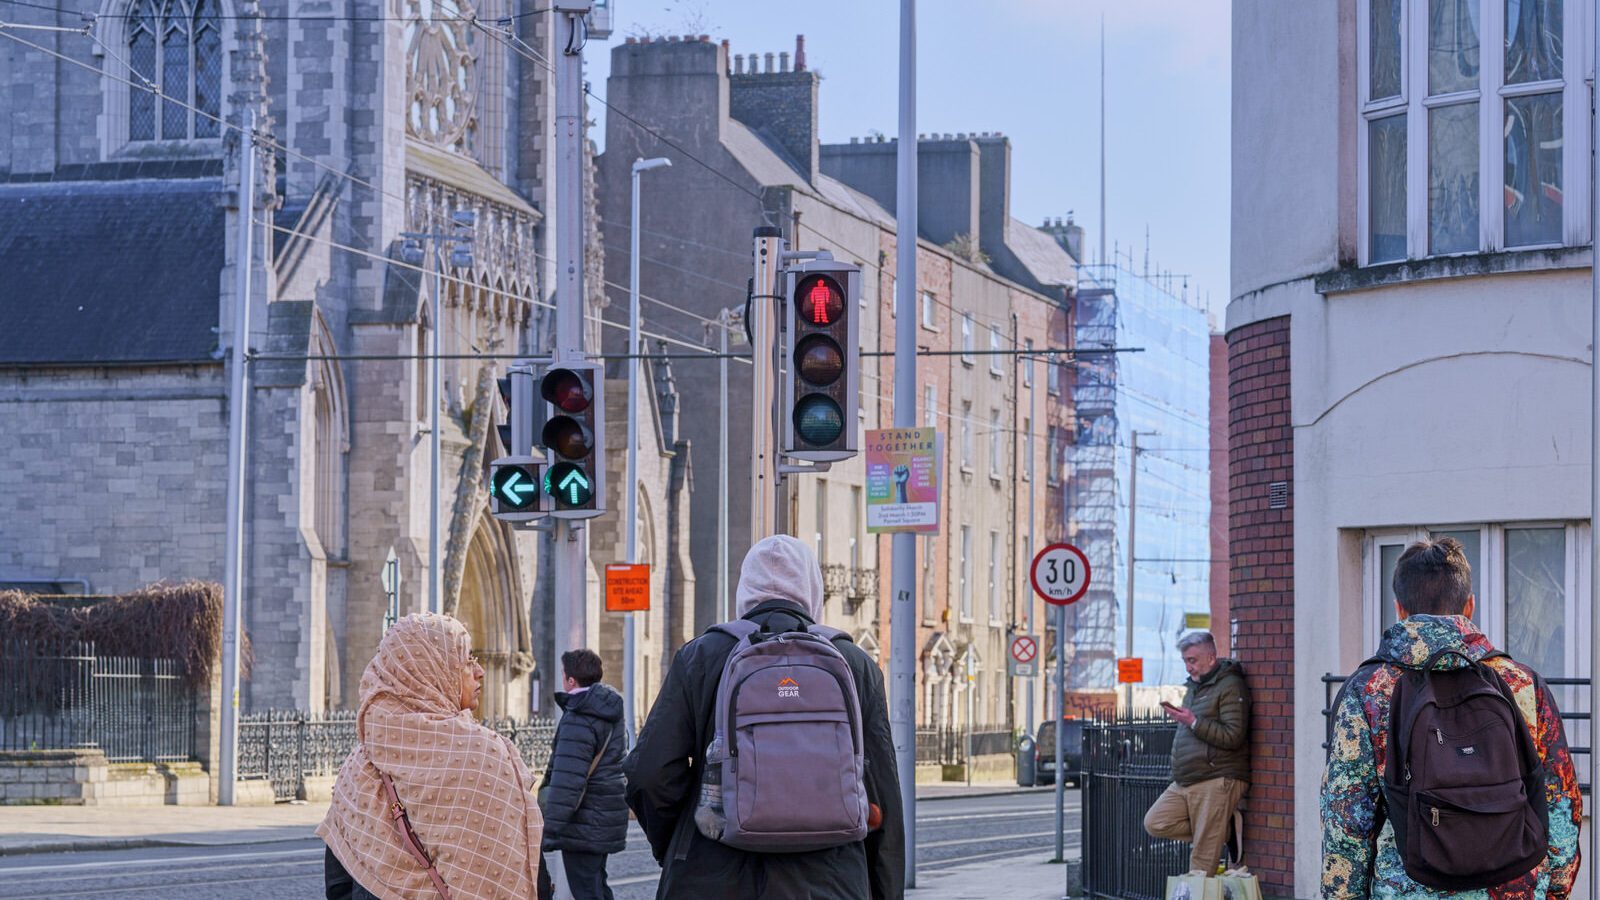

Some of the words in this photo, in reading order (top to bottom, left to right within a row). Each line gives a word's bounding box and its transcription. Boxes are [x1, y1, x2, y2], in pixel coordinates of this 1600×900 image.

[880, 432, 920, 440] STAND
[868, 442, 933, 452] TOGETHER
[1046, 559, 1075, 584] 30
[1049, 587, 1072, 595] km/h
